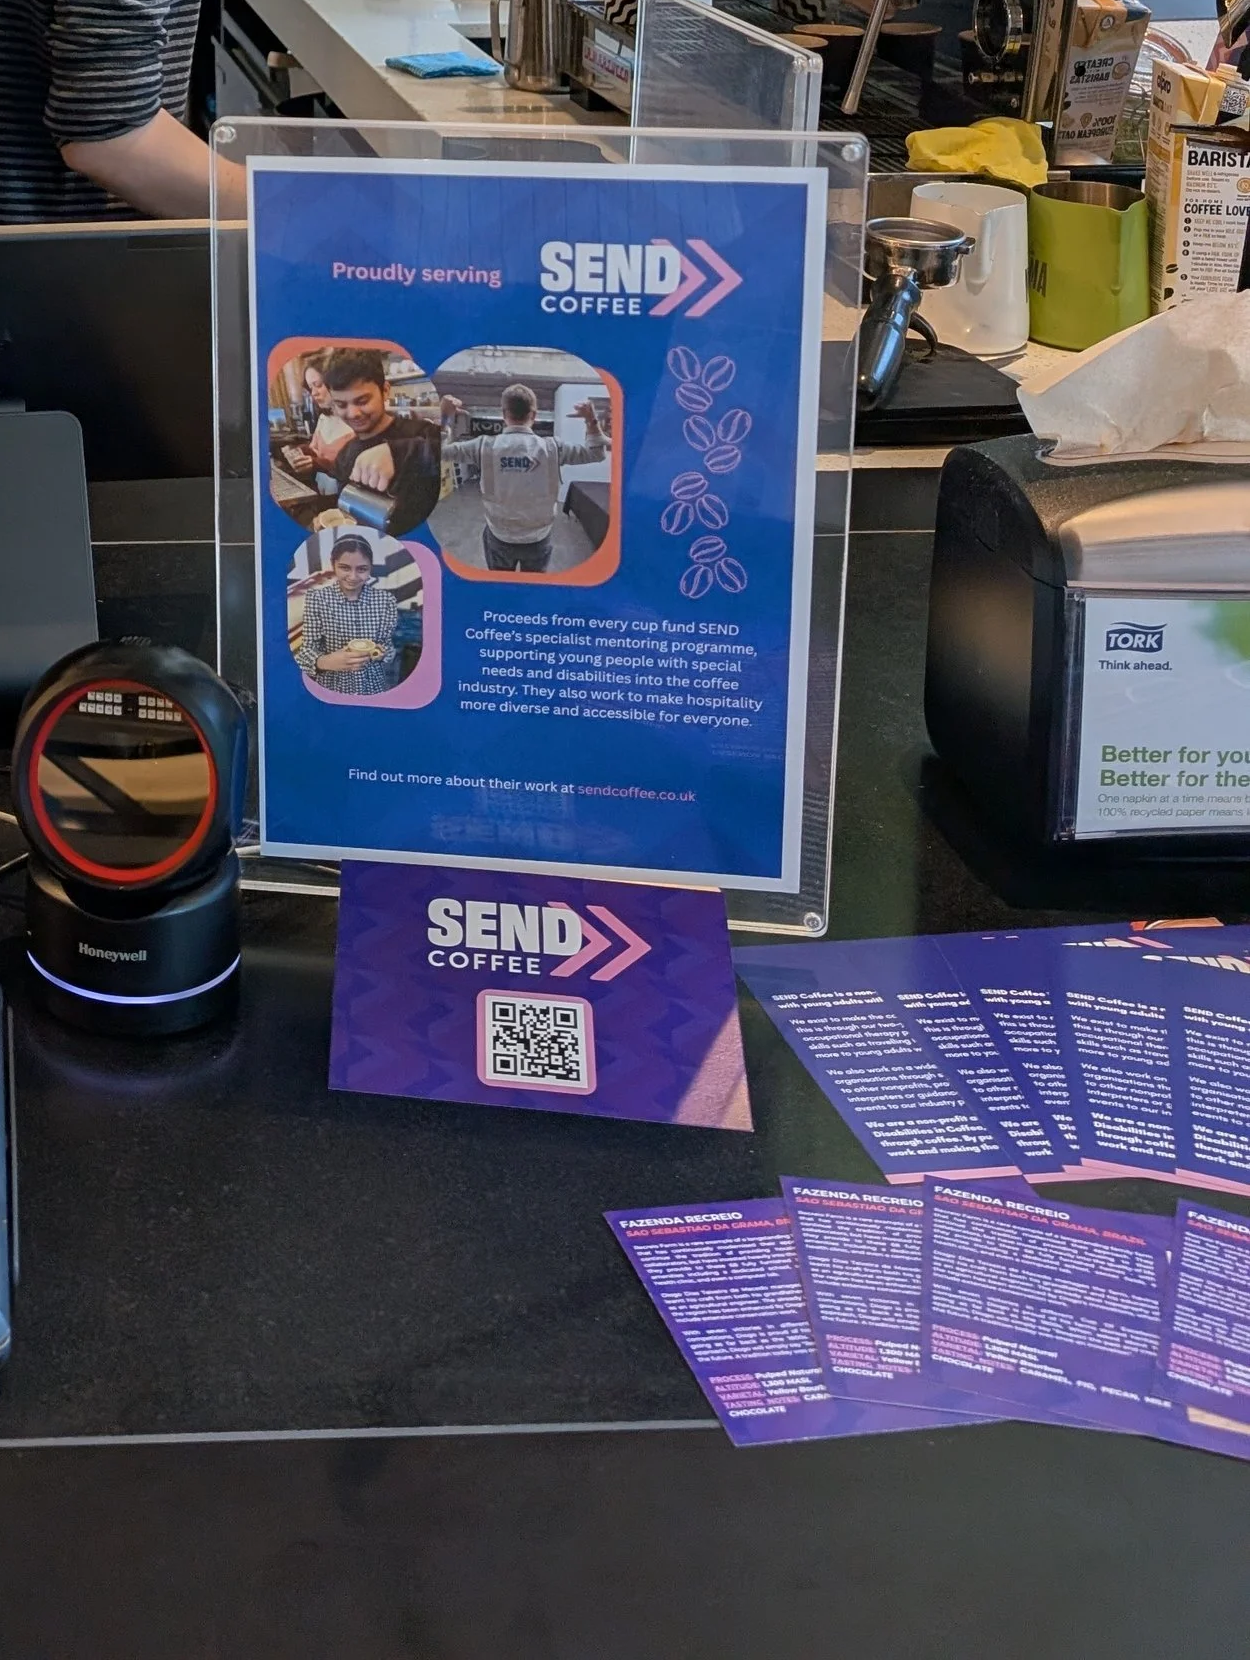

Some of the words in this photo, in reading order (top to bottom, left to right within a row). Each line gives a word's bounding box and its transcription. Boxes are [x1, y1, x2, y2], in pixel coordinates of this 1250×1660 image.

[1184, 203, 1223, 216] COFFEE
[332, 262, 416, 287] Proudly
[421, 266, 502, 288] serving
[539, 240, 682, 295] SEND
[540, 295, 642, 317] COFFEE
[500, 456, 530, 469] SEND
[483, 611, 549, 626] Proceeds
[552, 614, 589, 627] from
[588, 620, 628, 632] every
[632, 621, 659, 633] cup
[662, 620, 695, 633] fund
[699, 623, 739, 636] SEND
[465, 628, 522, 642] Coffee's
[525, 633, 592, 646] specialist
[595, 637, 668, 653] mentoring
[671, 641, 758, 657] programme,
[1107, 633, 1162, 649] TORK
[479, 648, 556, 664] supporting
[558, 653, 602, 667] young
[605, 655, 654, 669] people
[657, 657, 688, 669] with
[691, 660, 742, 673] special
[1098, 660, 1131, 670] Think
[1133, 660, 1173, 671] ahead.
[482, 666, 523, 678] needs
[526, 669, 553, 680] and
[556, 669, 632, 684] disabilities
[635, 673, 663, 686] into
[666, 675, 690, 687] the
[693, 678, 739, 690] coffee
[458, 680, 519, 697] industry.
[522, 684, 555, 699] They
[559, 687, 587, 699] also
[590, 690, 625, 702] work
[628, 692, 643, 702] to
[646, 693, 684, 705] make
[686, 694, 763, 712] hospitality
[460, 699, 496, 711] more
[499, 701, 550, 714] diverse
[553, 705, 579, 717] and
[583, 708, 656, 721] accessible
[659, 710, 680, 722] for
[683, 713, 752, 728] everyone.
[1101, 745, 1172, 764] Better
[1178, 746, 1211, 764] for
[348, 768, 378, 781] Find
[381, 771, 404, 784] out
[407, 773, 443, 786] more
[445, 774, 486, 788] about
[488, 776, 521, 790] their
[524, 779, 558, 793] work
[561, 781, 575, 794] at
[577, 783, 696, 803] sendcoffee.co.uk
[1099, 769, 1170, 787] Better
[1177, 770, 1209, 787] for
[1216, 770, 1250, 787] the
[1097, 793, 1119, 804] One
[1122, 793, 1157, 806] napkin
[1159, 795, 1170, 804] at
[1172, 796, 1179, 804] a
[1182, 794, 1204, 804] time
[1207, 796, 1242, 804] means
[1098, 807, 1127, 817] 100%
[1129, 807, 1173, 818] recycled
[1175, 808, 1206, 818] paper
[1208, 808, 1243, 817] means
[426, 897, 583, 957] SEND
[78, 942, 148, 963] Honeywell
[427, 949, 542, 976] COFFEE
[934, 1186, 1003, 1207] FAZENDA
[1006, 1201, 1070, 1221] RECREIO
[619, 1216, 684, 1229] FAZENDA
[684, 1212, 743, 1224] RECREIO
[729, 1405, 787, 1418] CHOCOLATE
